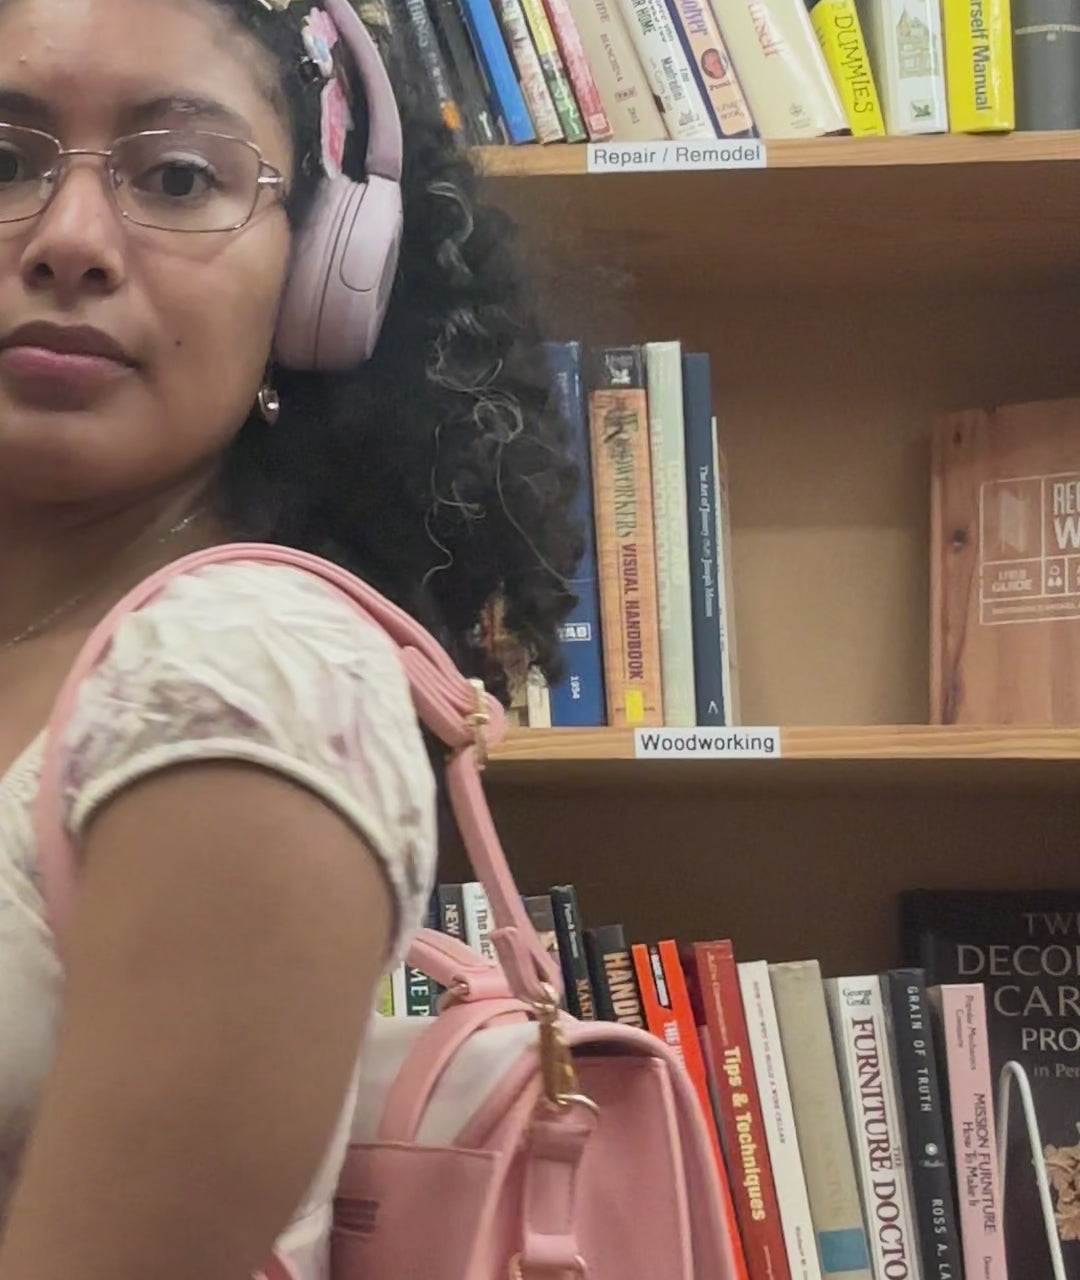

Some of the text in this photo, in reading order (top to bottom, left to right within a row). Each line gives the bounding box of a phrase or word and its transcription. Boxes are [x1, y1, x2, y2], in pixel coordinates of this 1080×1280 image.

[637, 7, 658, 37] HOME
[834, 14, 875, 115] DUMMIES
[973, 45, 993, 111] Manual
[594, 145, 761, 167] Repair / Remodel
[622, 542, 644, 680] VISUAL HANDBOOK
[640, 733, 775, 754] Woodworking
[956, 944, 1080, 976] DECO
[906, 985, 932, 1112] GRAIN OF TRUTH
[724, 1046, 765, 1221] Tips & Techniques
[851, 1016, 896, 1172] FURNITURE
[973, 1092, 998, 1233] MISSION FURNITURE
[931, 1198, 947, 1234] ROSS
